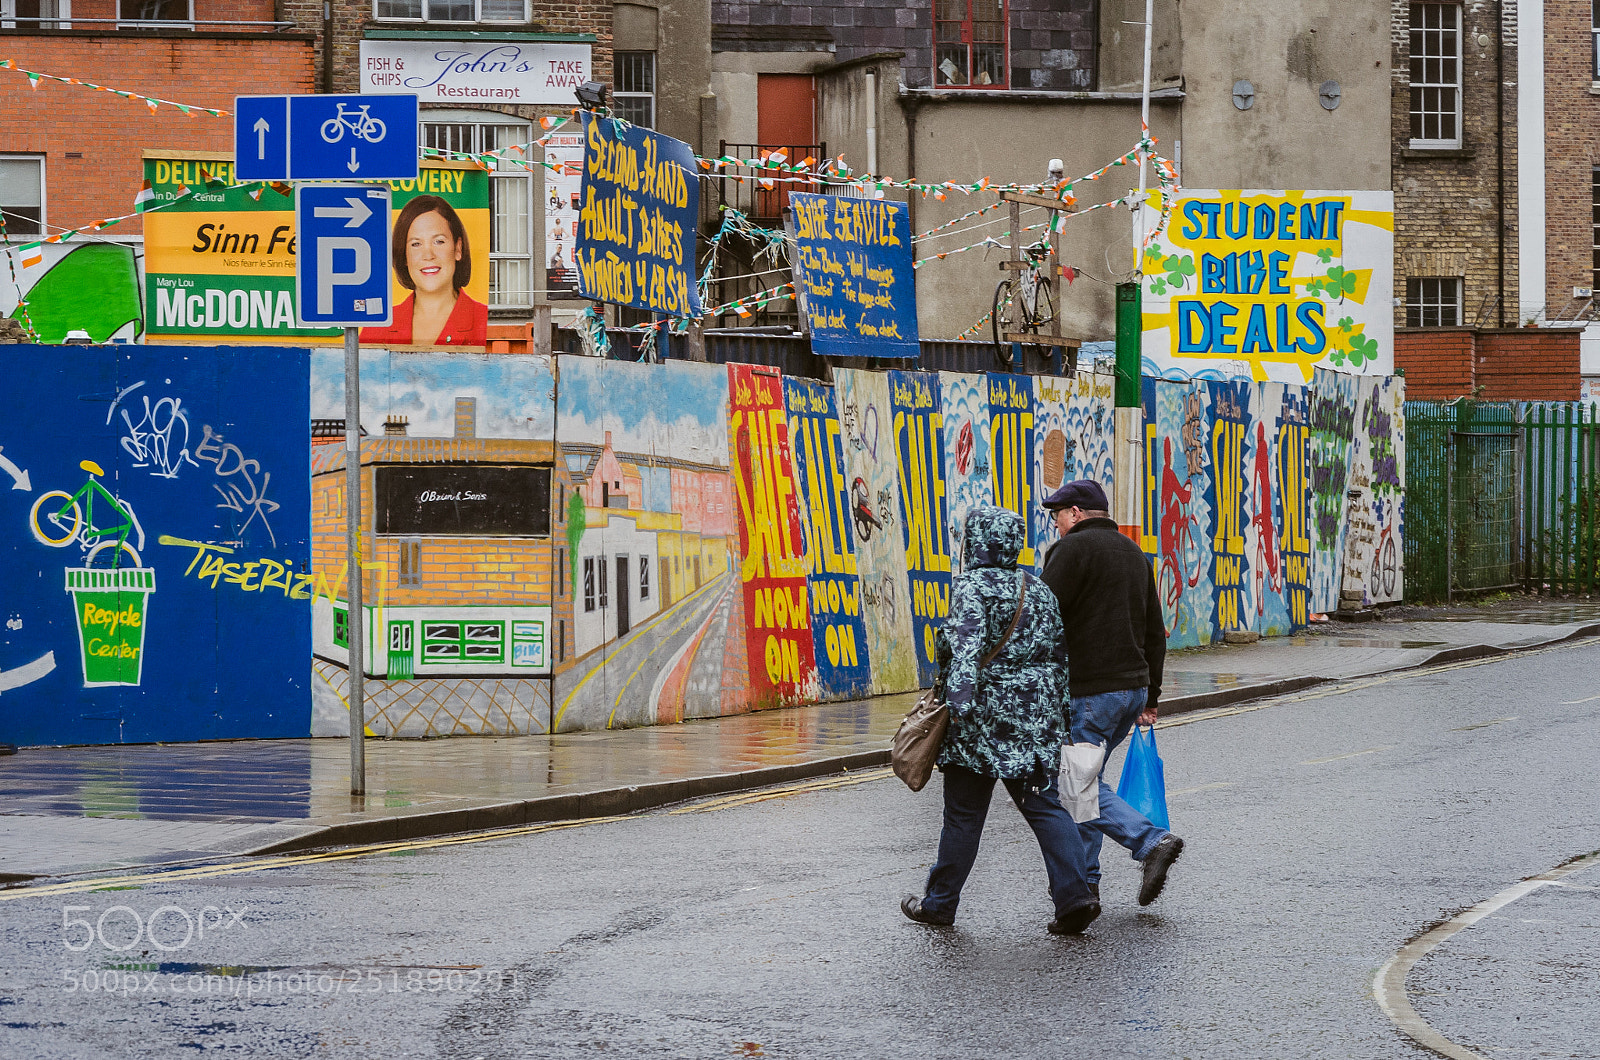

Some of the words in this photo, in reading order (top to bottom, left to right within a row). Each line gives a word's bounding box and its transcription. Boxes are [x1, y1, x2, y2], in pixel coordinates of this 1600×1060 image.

[367, 57, 391, 71] FISH
[395, 57, 405, 71] &
[370, 73, 401, 86] CHIPS
[404, 46, 534, 89] John's
[545, 75, 586, 89] AWAY
[548, 60, 583, 74] TAKE
[437, 84, 520, 100] Restaurant
[155, 160, 238, 187] DELIVE
[195, 192, 225, 202] Central
[581, 184, 638, 249] ADULT
[192, 223, 259, 255] Sinn
[266, 225, 297, 255] Fé
[1181, 200, 1345, 241] STUDENT
[156, 278, 177, 288] Mary
[178, 278, 194, 288] Lou
[317, 236, 372, 315] P
[577, 247, 634, 304] WANTED
[1201, 249, 1290, 294] BIKE
[156, 288, 300, 329] McDONA
[1177, 300, 1327, 355] DEALS
[731, 409, 806, 583] SALE
[788, 415, 858, 576] SALE
[894, 411, 952, 573] SALE
[1212, 418, 1245, 555] SALE
[1278, 423, 1310, 554] SALE
[1215, 555, 1241, 586] NOW
[1286, 554, 1308, 586] NOW
[754, 586, 807, 630] NOW
[812, 579, 859, 617] NOW
[913, 579, 949, 619] NOW
[1218, 588, 1238, 630] ON
[83, 603, 141, 636] Recycle
[88, 638, 140, 660] Center
[765, 634, 800, 686] ON
[825, 624, 858, 668] ON
